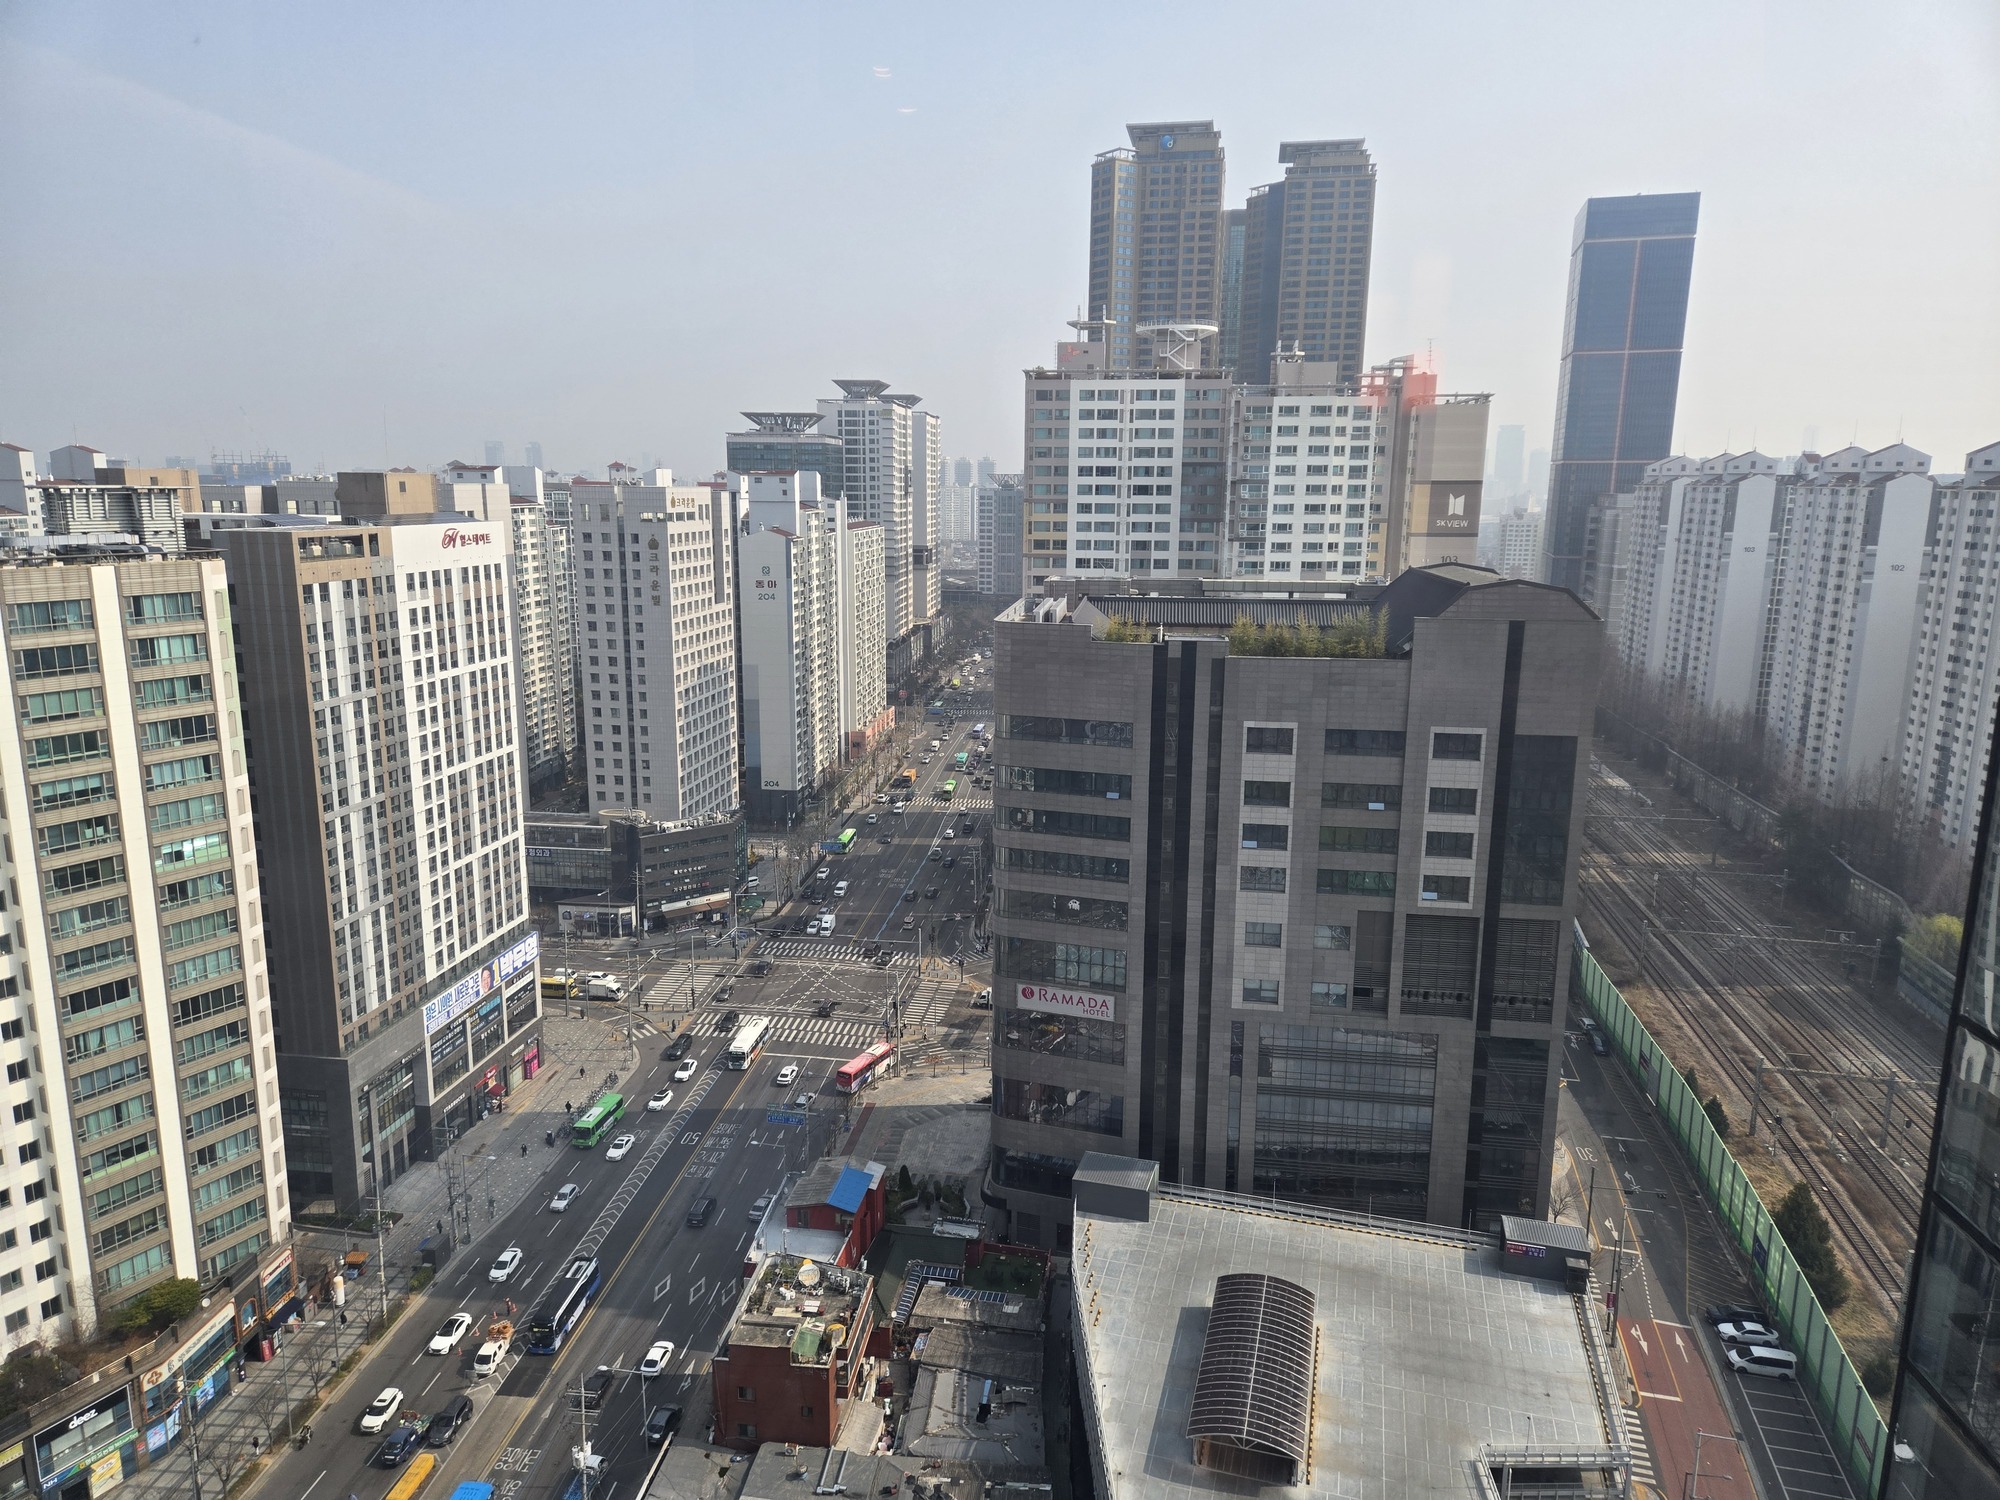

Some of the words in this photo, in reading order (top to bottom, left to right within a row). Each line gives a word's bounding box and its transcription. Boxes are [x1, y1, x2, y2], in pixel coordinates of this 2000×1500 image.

[1436, 519, 1446, 527] SK
[1446, 519, 1469, 528] VIEW
[460, 533, 492, 547] 힐스테이트
[1890, 564, 1905, 572] 102
[649, 552, 661, 607] 크라운빌
[758, 592, 776, 601] 204
[454, 979, 470, 1003] 새로운
[470, 972, 480, 992] 구로
[499, 934, 539, 980] 박무영
[1038, 988, 1110, 1010] RAMADA
[1082, 1007, 1110, 1018] HOTEL
[680, 1131, 702, 1145] 50
[1575, 1146, 1598, 1162] 30
[68, 1408, 98, 1430] deez
[43, 1478, 58, 1490] NH
